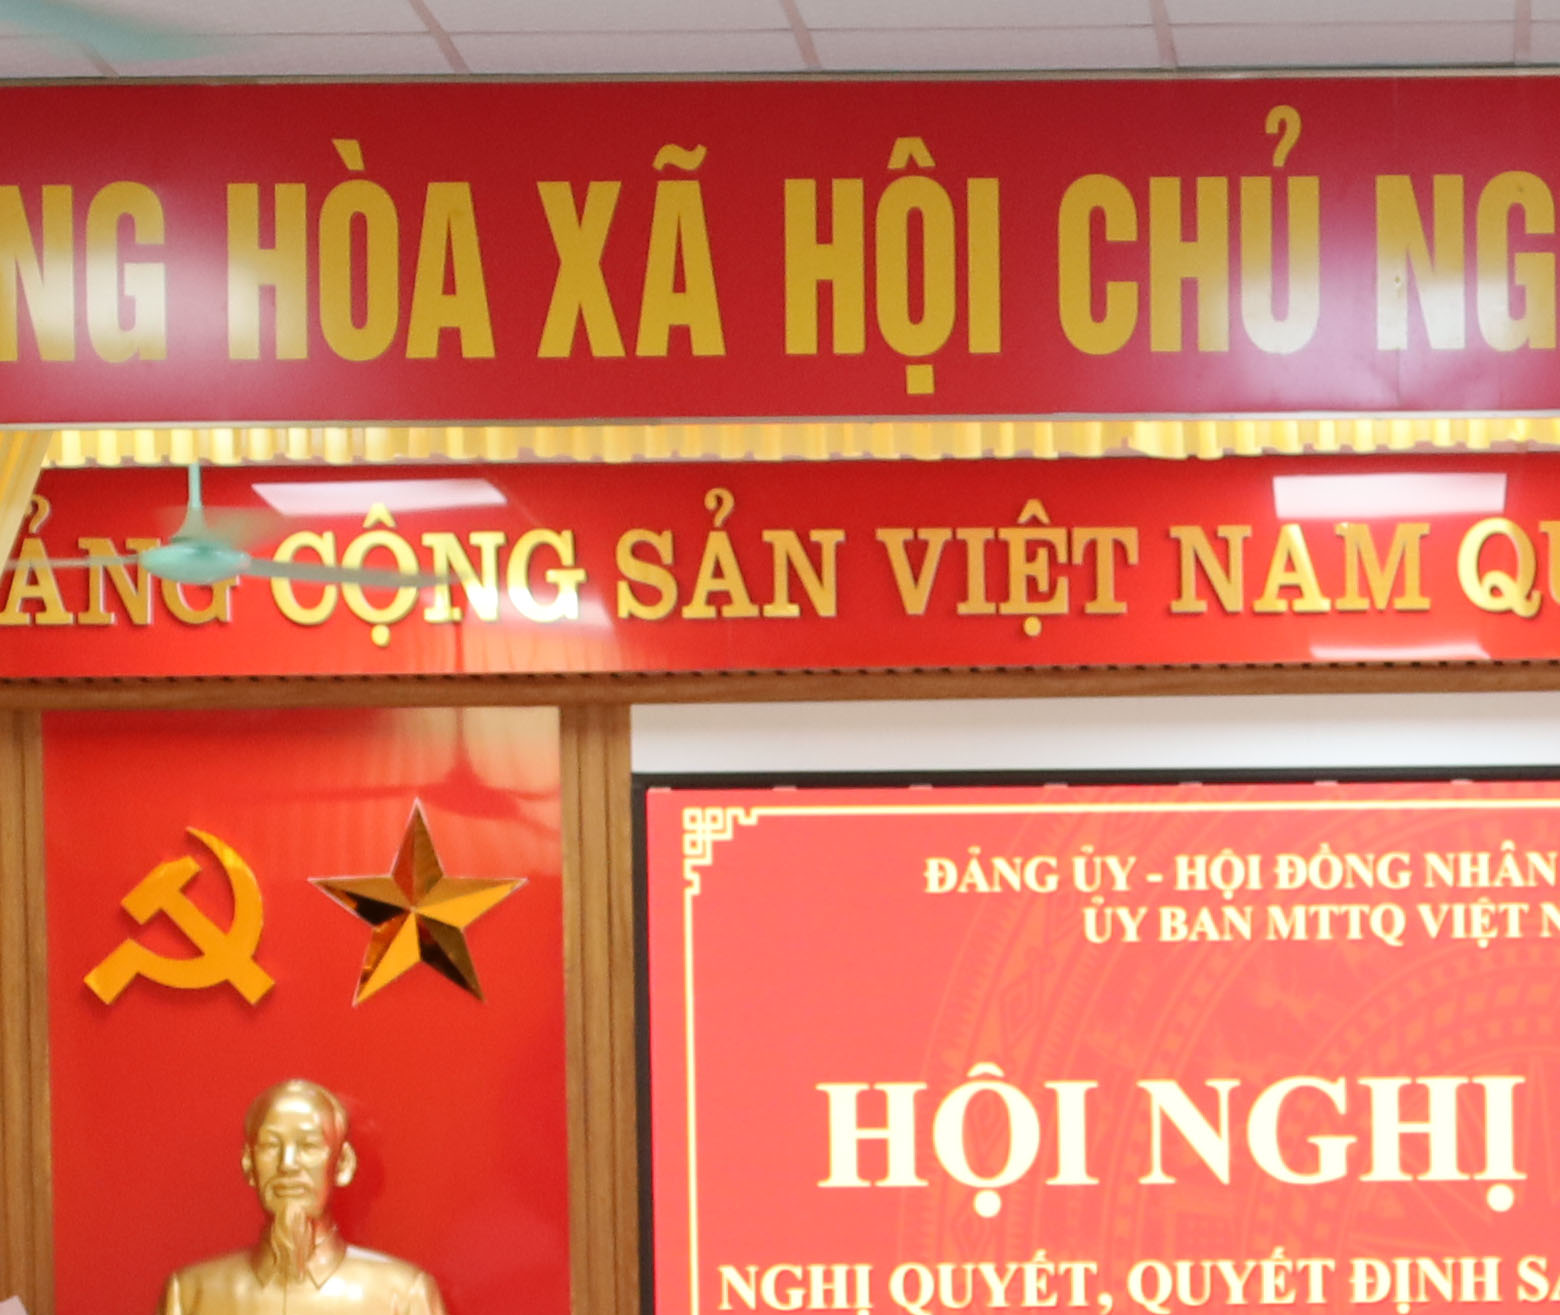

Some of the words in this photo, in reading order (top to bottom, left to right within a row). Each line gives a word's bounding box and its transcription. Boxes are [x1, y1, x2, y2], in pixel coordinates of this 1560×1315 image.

[220, 140, 495, 373] HÒA
[538, 144, 725, 358] XÃ
[785, 138, 1001, 394] HỘI
[1059, 106, 1332, 365] CHỦ
[270, 502, 586, 646] CỘNG
[616, 489, 845, 620] SẢN
[876, 500, 1139, 636] VIỆT
[1172, 520, 1432, 614] NAM
[924, 846, 1059, 893] ĐẢNG
[1072, 845, 1136, 892] ỦY
[1176, 848, 1262, 899] HỘI
[1274, 843, 1411, 889] ĐỒNG
[1424, 840, 1557, 888] NHÂN
[1083, 896, 1147, 943] ỦY
[1160, 906, 1253, 941] BAN
[1267, 903, 1406, 946] MTTQ
[1417, 897, 1529, 948] VIỆT
[816, 1062, 1099, 1217] HỘI
[1137, 1076, 1526, 1211] NGHỊ
[1127, 1246, 1335, 1314] QUYẾT
[1349, 1256, 1501, 1314] ĐỊNH
